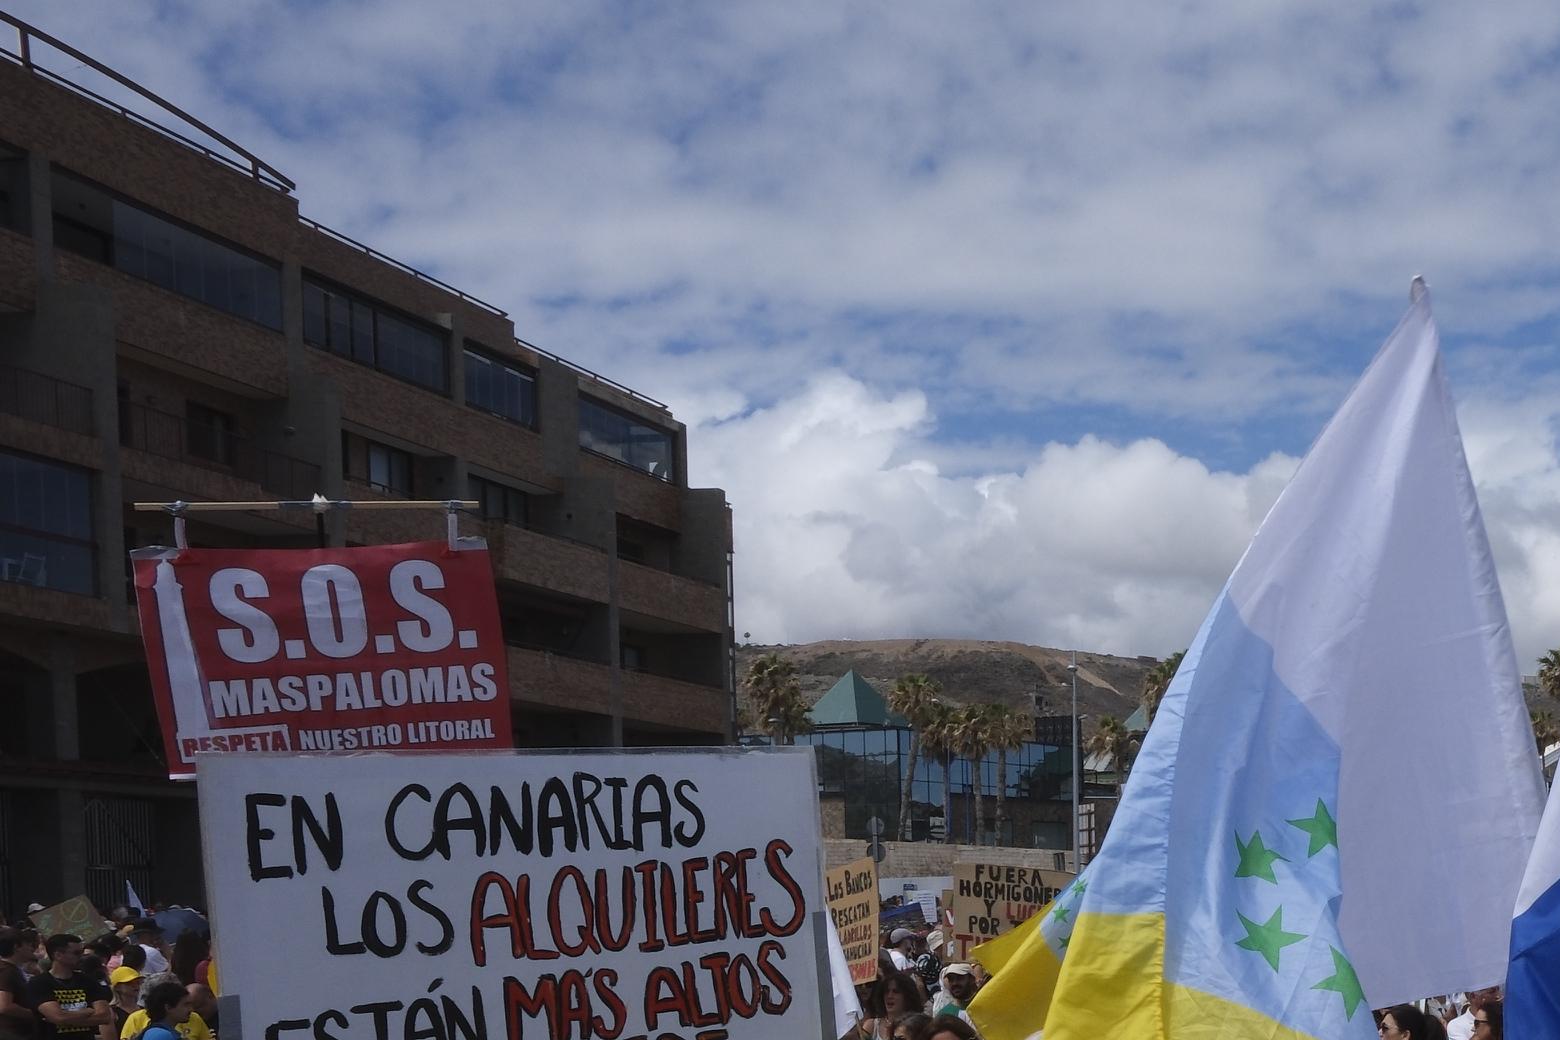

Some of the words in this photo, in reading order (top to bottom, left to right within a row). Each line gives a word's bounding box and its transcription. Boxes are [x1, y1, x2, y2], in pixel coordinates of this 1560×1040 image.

[208, 560, 479, 664] S.O.S.
[208, 661, 498, 719] MASPALOMAS
[299, 724, 401, 750] NUESTRO
[408, 719, 496, 743] LITORAL
[246, 792, 343, 881] EN
[385, 771, 706, 860] CANARIAS
[322, 881, 454, 956] LOS
[470, 839, 806, 966] ALQUILERES
[975, 864, 1044, 886] FUERA
[969, 915, 1001, 936] POR
[984, 900, 996, 918] Y
[645, 941, 793, 1032] ALTOS
